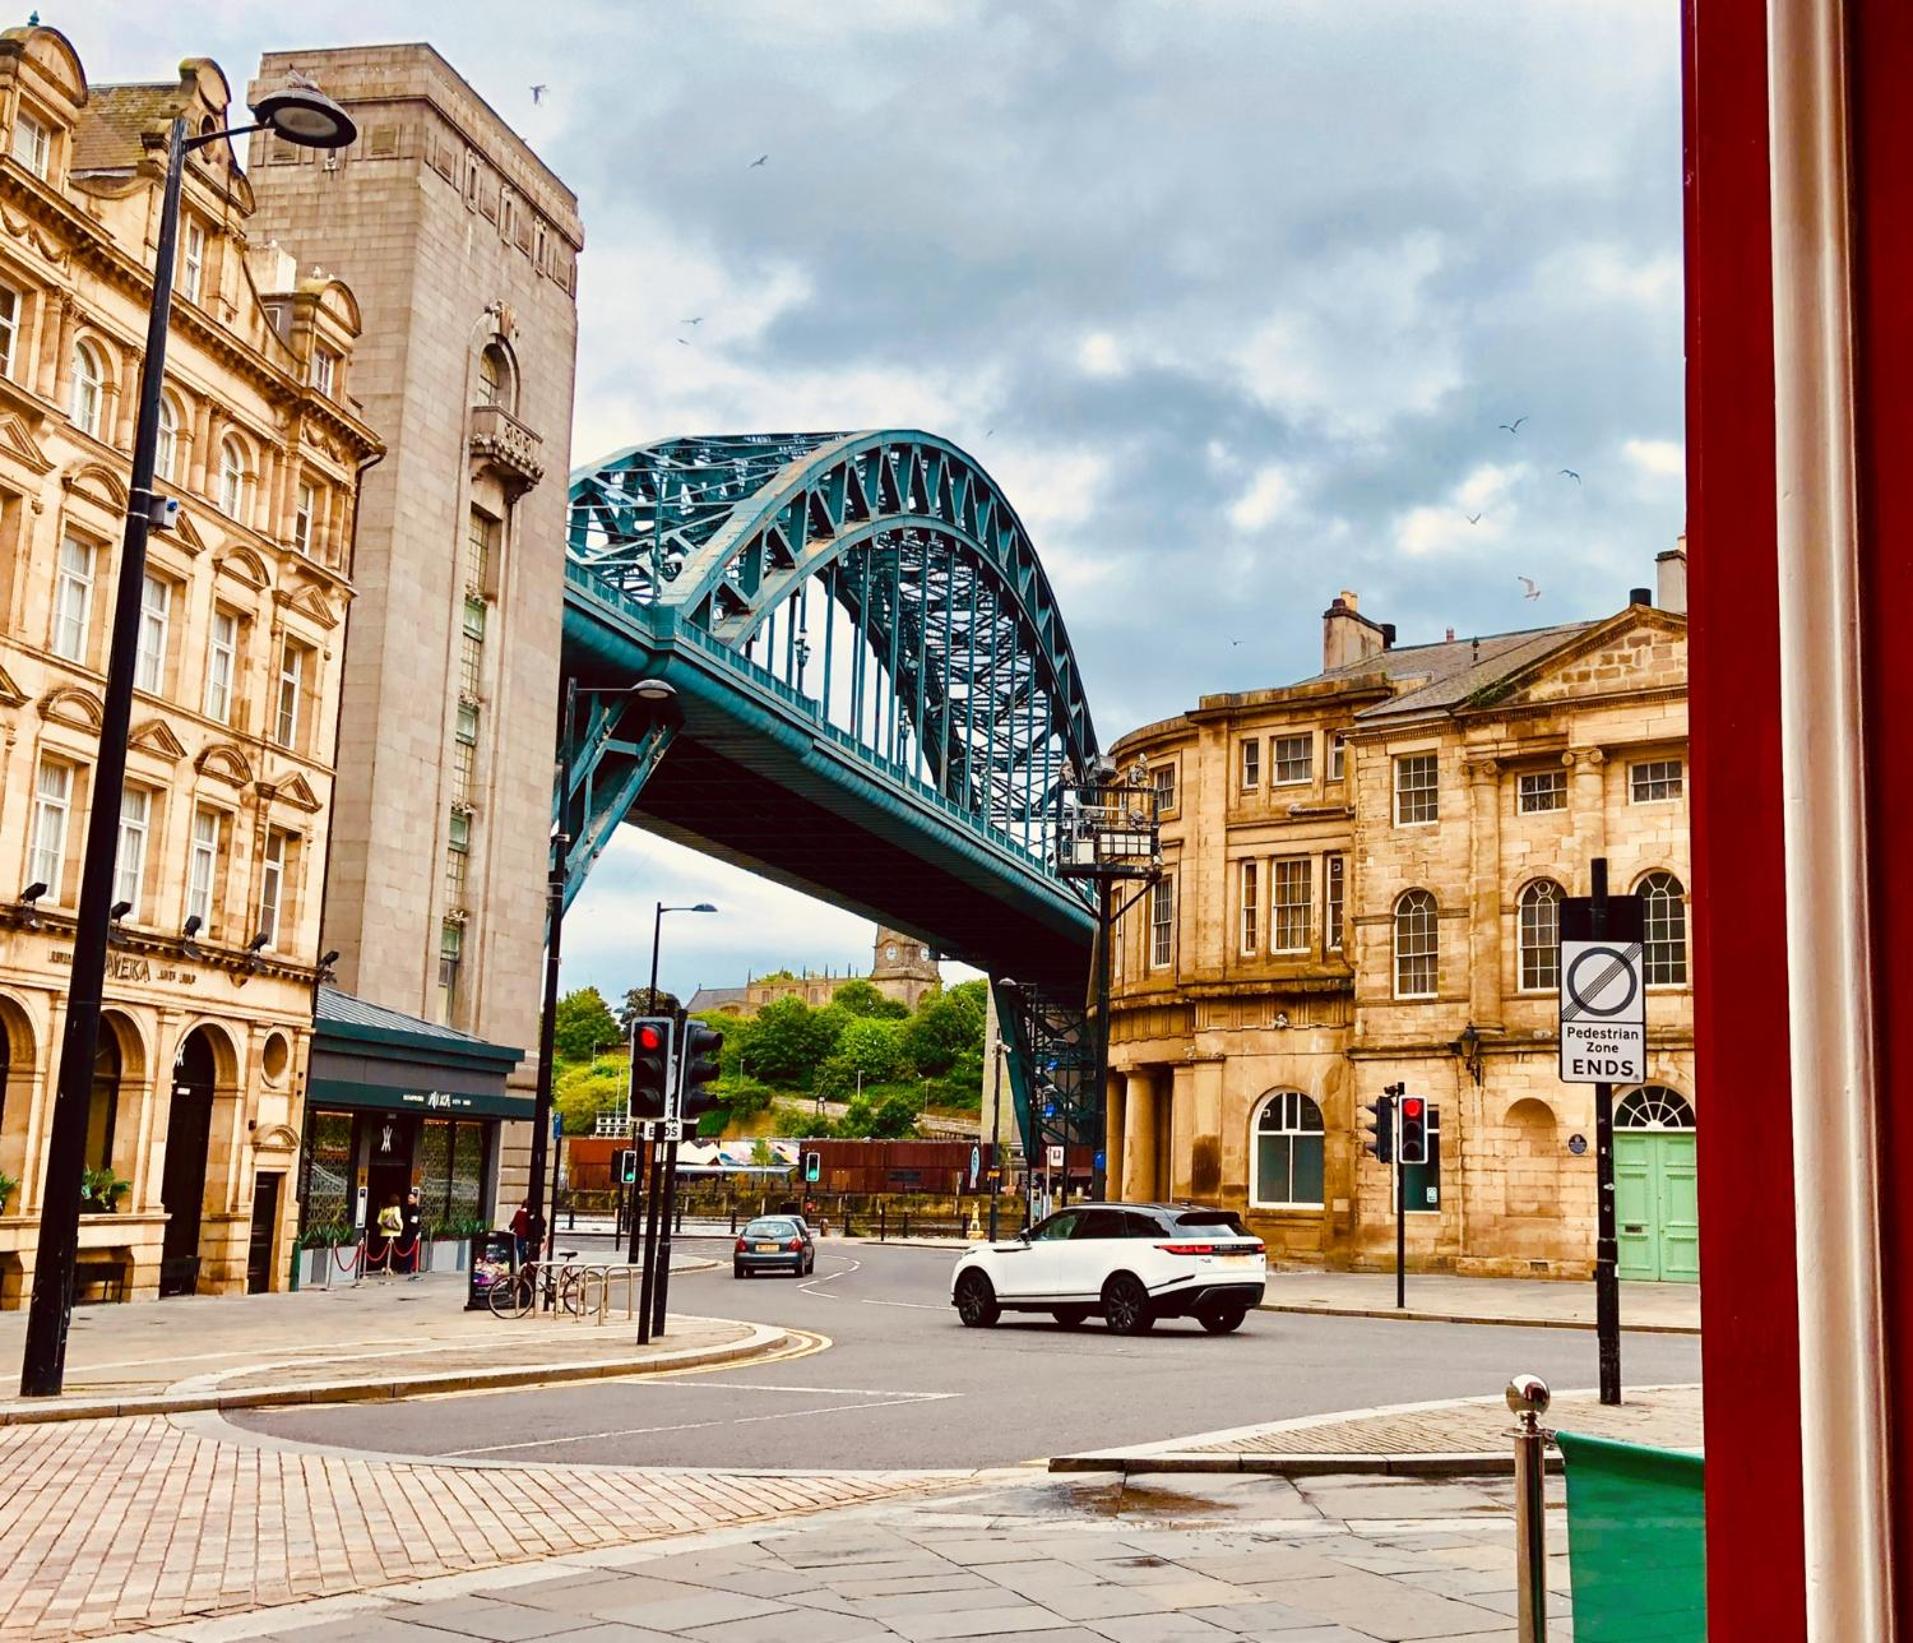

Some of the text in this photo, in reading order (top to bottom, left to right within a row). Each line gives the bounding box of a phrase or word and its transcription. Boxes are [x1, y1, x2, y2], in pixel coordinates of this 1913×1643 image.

[1567, 1027, 1639, 1039] Pedestrian
[1586, 1042, 1619, 1053] Zone
[1573, 1059, 1634, 1077] ENDS
[649, 1127, 677, 1137] EDS
